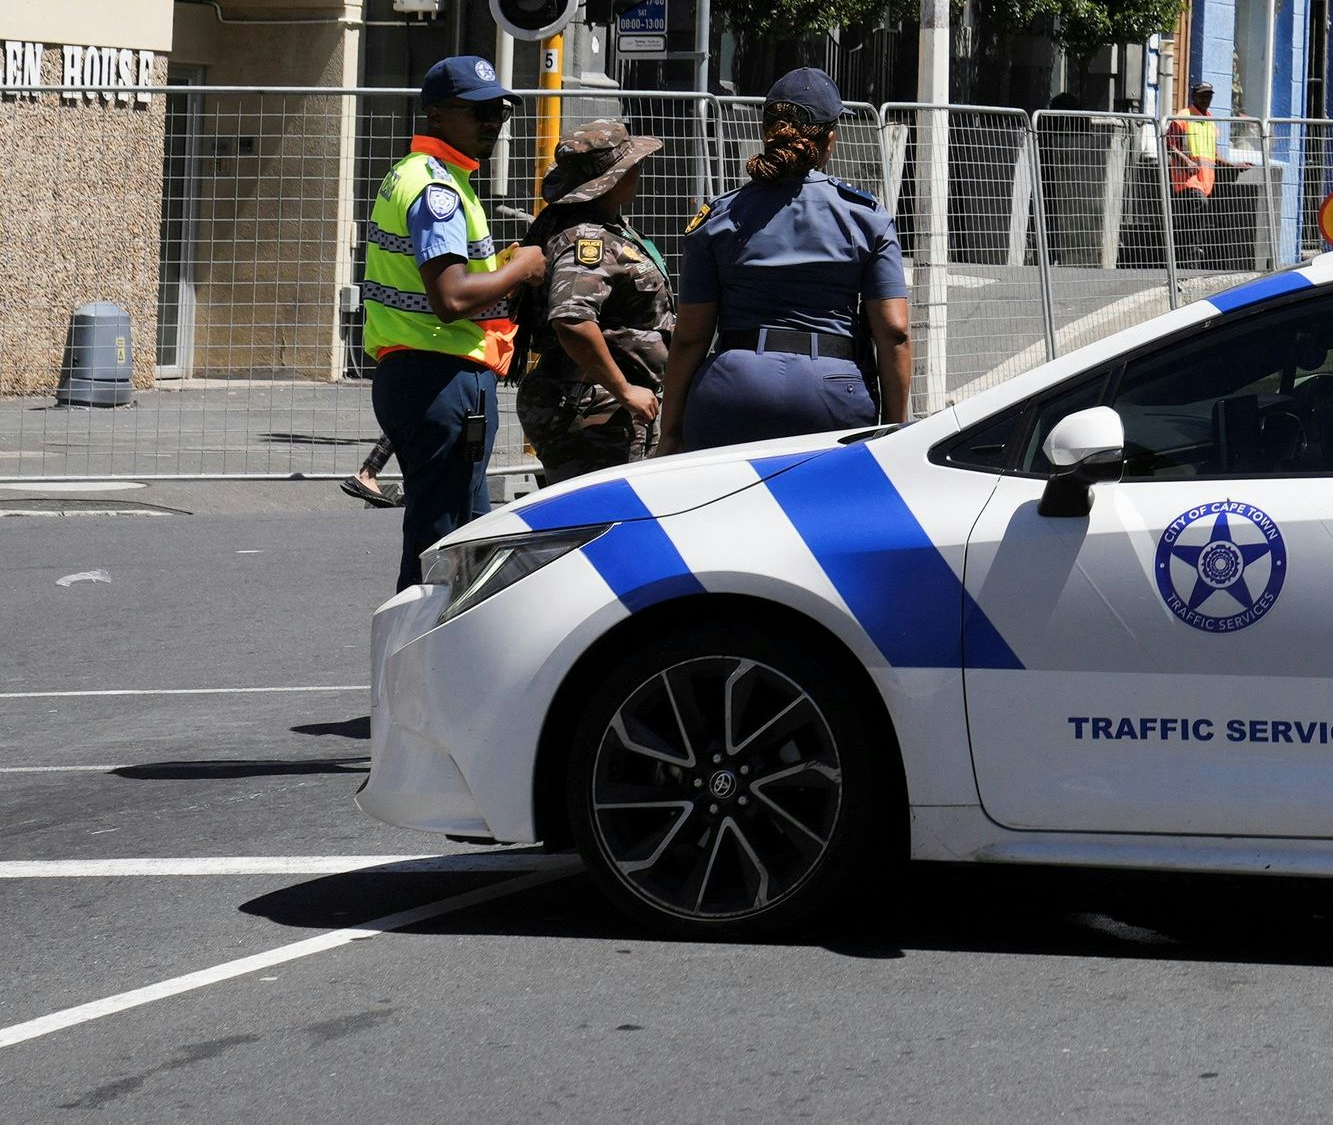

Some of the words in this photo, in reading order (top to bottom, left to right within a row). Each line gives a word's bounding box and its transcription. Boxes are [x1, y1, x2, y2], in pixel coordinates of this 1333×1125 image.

[5, 40, 43, 97] EN
[62, 45, 155, 103] HOUSE
[545, 52, 553, 69] 5
[1164, 516, 1187, 543] CITY
[1188, 506, 1207, 519] OF
[1211, 503, 1246, 514] CAPE
[1247, 507, 1278, 540] TOWN
[1167, 593, 1213, 630] TRAFFIC
[1219, 592, 1274, 630] SERVICES
[1068, 716, 1215, 742] TRAFFIC
